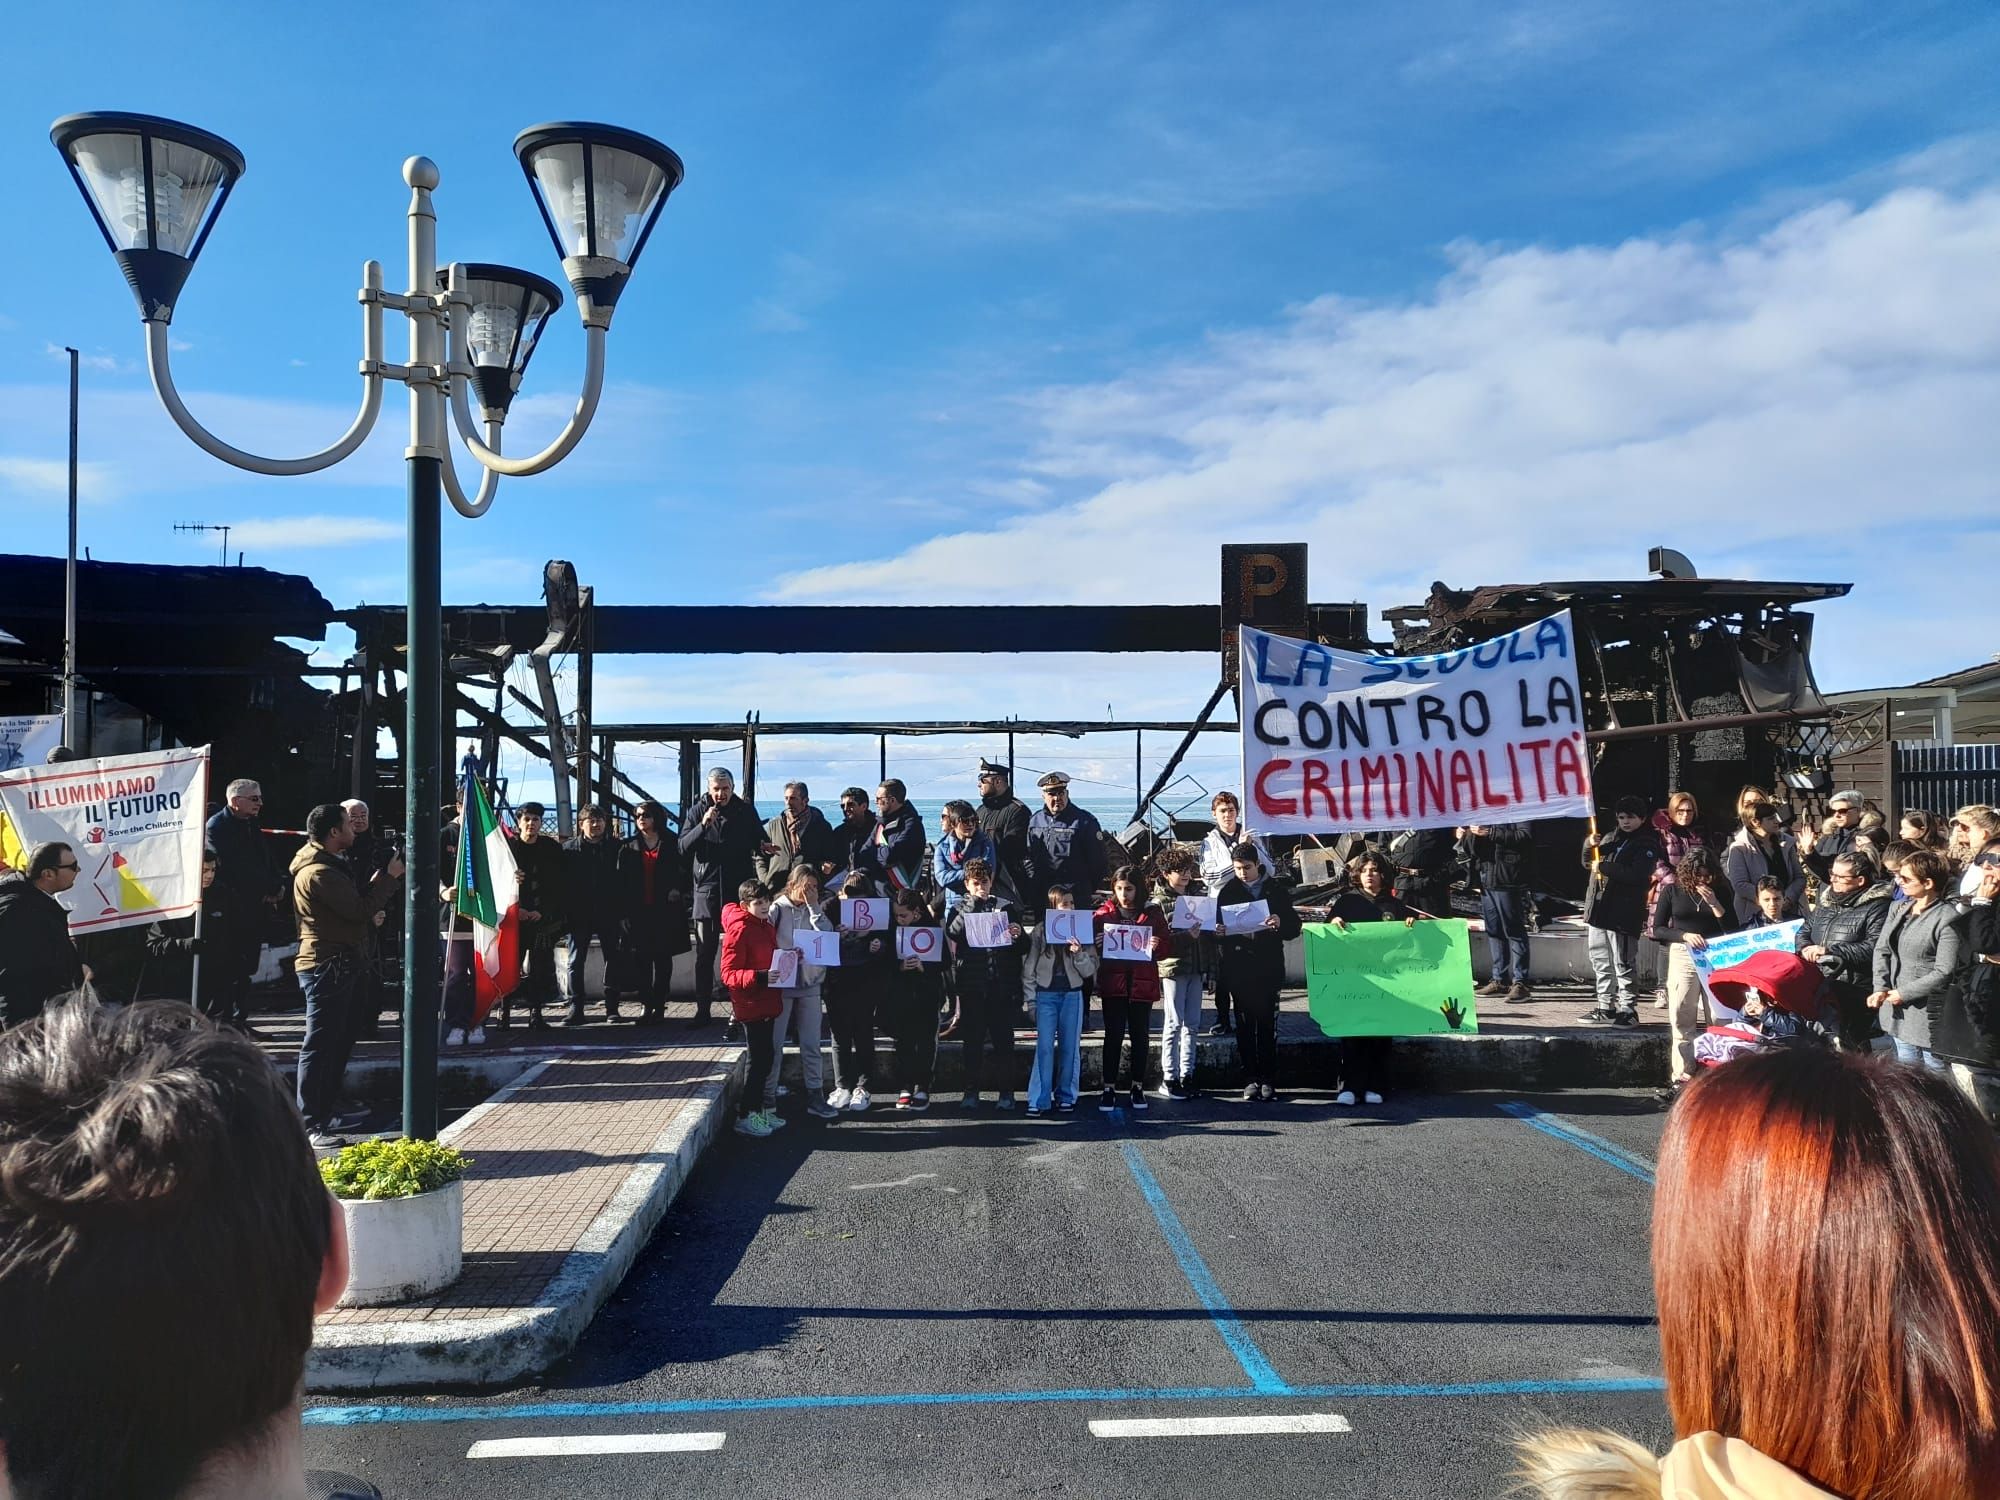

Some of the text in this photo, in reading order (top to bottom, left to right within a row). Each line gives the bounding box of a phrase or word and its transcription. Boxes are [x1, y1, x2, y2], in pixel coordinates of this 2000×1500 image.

[1240, 553, 1288, 618] P
[1256, 635, 1332, 686] LA
[1254, 676, 1577, 749] CONTRO LA
[27, 775, 156, 810] ILLUMINIAMO
[85, 791, 181, 824] IL FUTURO
[108, 820, 183, 837] Save the Children
[853, 899, 874, 930] B
